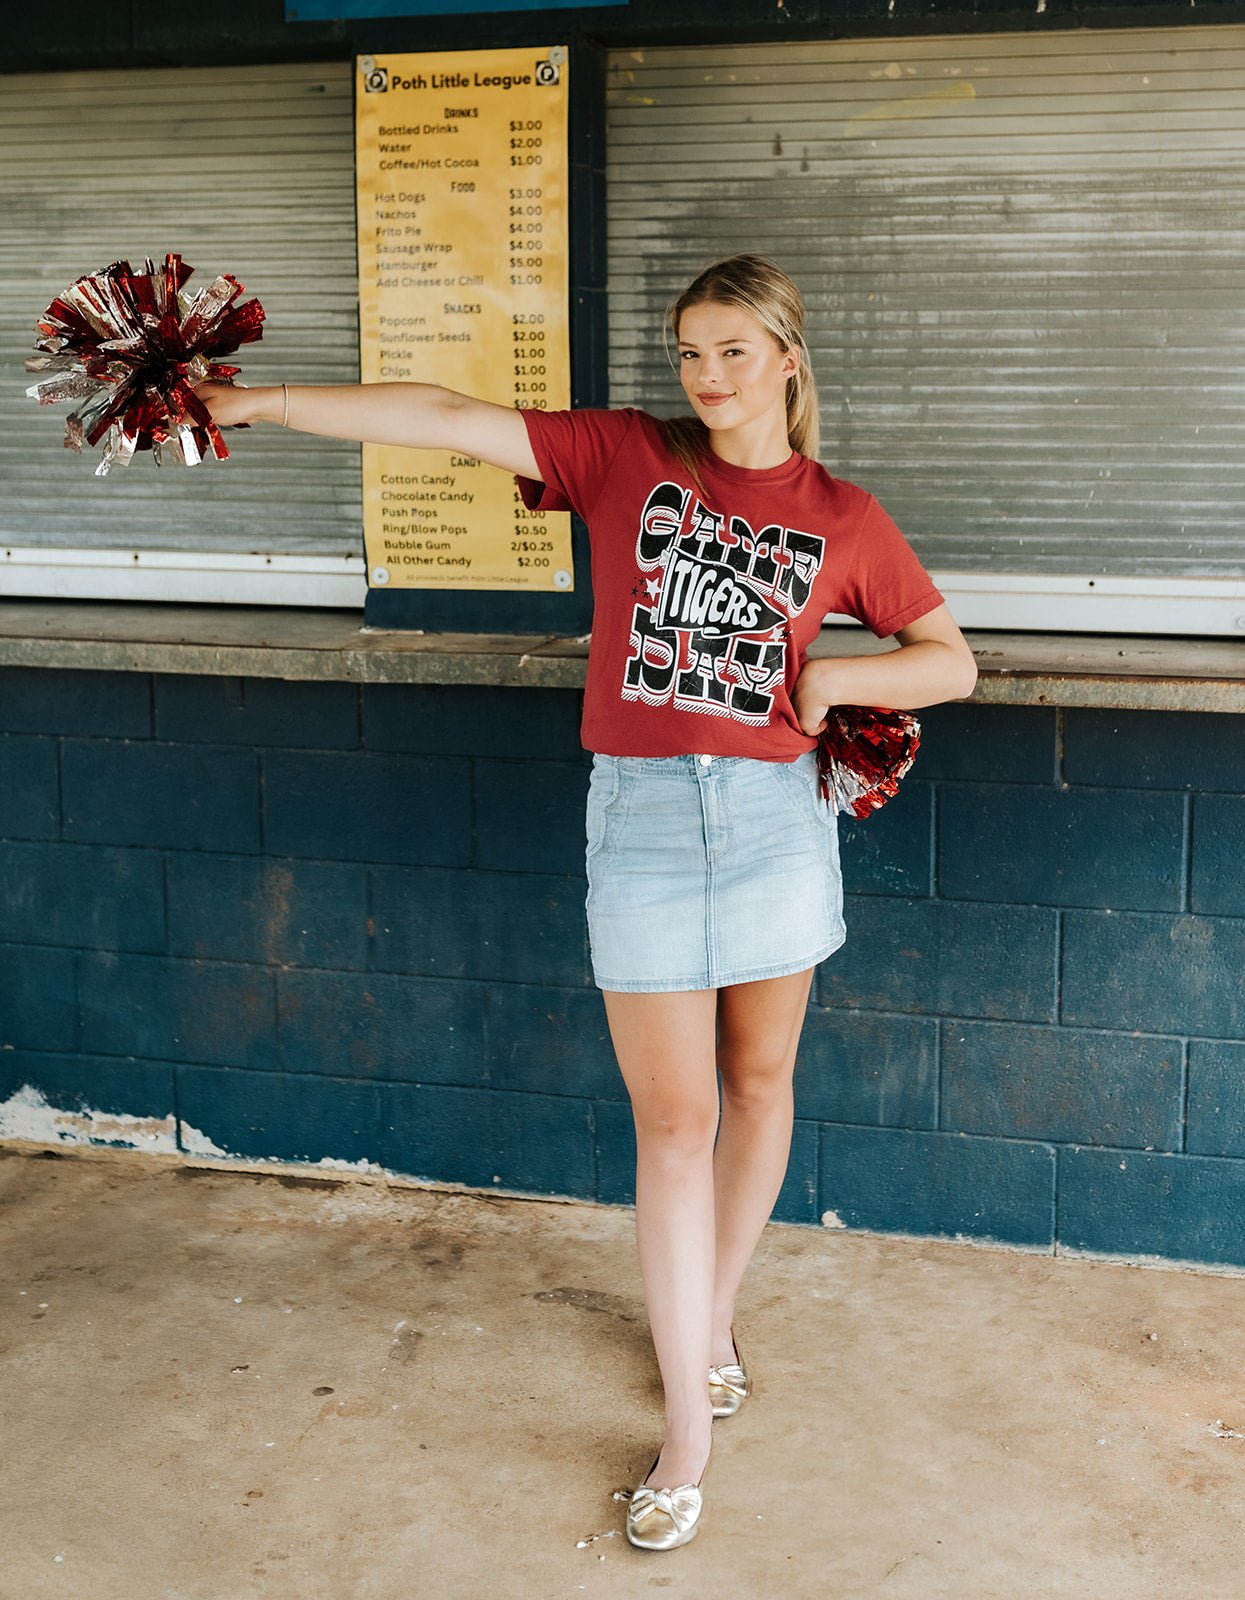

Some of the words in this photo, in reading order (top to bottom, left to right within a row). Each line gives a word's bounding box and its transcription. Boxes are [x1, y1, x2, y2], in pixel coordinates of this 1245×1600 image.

[392, 75, 427, 90] Poth
[432, 73, 470, 88] Little
[474, 72, 531, 90] League
[444, 108, 479, 118] DRINKS
[379, 126, 420, 136] Bottled
[423, 124, 459, 134] Drinks
[509, 121, 542, 132] $3.00
[379, 144, 411, 153] Water
[510, 138, 542, 149] $2.00
[379, 160, 441, 171] Coffee/Hot
[444, 159, 479, 168] Cocoa
[511, 155, 542, 166] $1.00
[375, 193, 395, 203] Hot
[399, 192, 426, 203] Dogs
[509, 189, 542, 199] $3.00
[376, 210, 416, 219] Nachos
[509, 206, 542, 217] $4.00
[376, 228, 402, 237] Frito
[405, 227, 422, 236] Pie
[509, 223, 543, 234] $4.00
[376, 244, 421, 255] Sausage
[425, 243, 453, 254] Wrap
[510, 241, 543, 251] $4.00
[376, 261, 438, 272] Hamburger
[510, 258, 543, 268] $5.00
[376, 278, 398, 288] Add
[401, 277, 441, 287] Cheese
[458, 276, 484, 286] Chili
[511, 275, 542, 285] $1.00
[444, 304, 481, 314] SNACKS
[380, 316, 426, 327] Popcorn
[512, 314, 545, 325] $2.00
[380, 333, 435, 343] Sunflower
[438, 333, 471, 342] Seeds
[513, 331, 545, 342] $2.00
[380, 350, 413, 360] Pickle
[514, 349, 545, 359] $1.00
[380, 367, 411, 377] Chips
[514, 365, 546, 376] $1.00
[514, 382, 546, 393] $1.00
[514, 400, 547, 409] $0.50
[381, 475, 418, 484] Cotton
[422, 475, 456, 487] Candy
[381, 492, 437, 501] Chocolate
[439, 491, 474, 504] Candy
[383, 508, 408, 517] Push
[411, 508, 438, 519] Pops
[514, 509, 546, 519] $1.00
[383, 525, 438, 535] Ring/Blow
[441, 525, 468, 536] Pops
[515, 525, 547, 536] $0.50
[384, 540, 422, 550] Bubble
[425, 541, 451, 550] Gum
[511, 542, 554, 552] 2/$0.25
[636, 481, 827, 619] GAME
[387, 557, 401, 565] All
[403, 556, 434, 565] Other
[437, 557, 472, 568] Candy
[518, 558, 550, 568] $2.00
[669, 560, 762, 628] TIGERS
[621, 603, 787, 727] DAY
